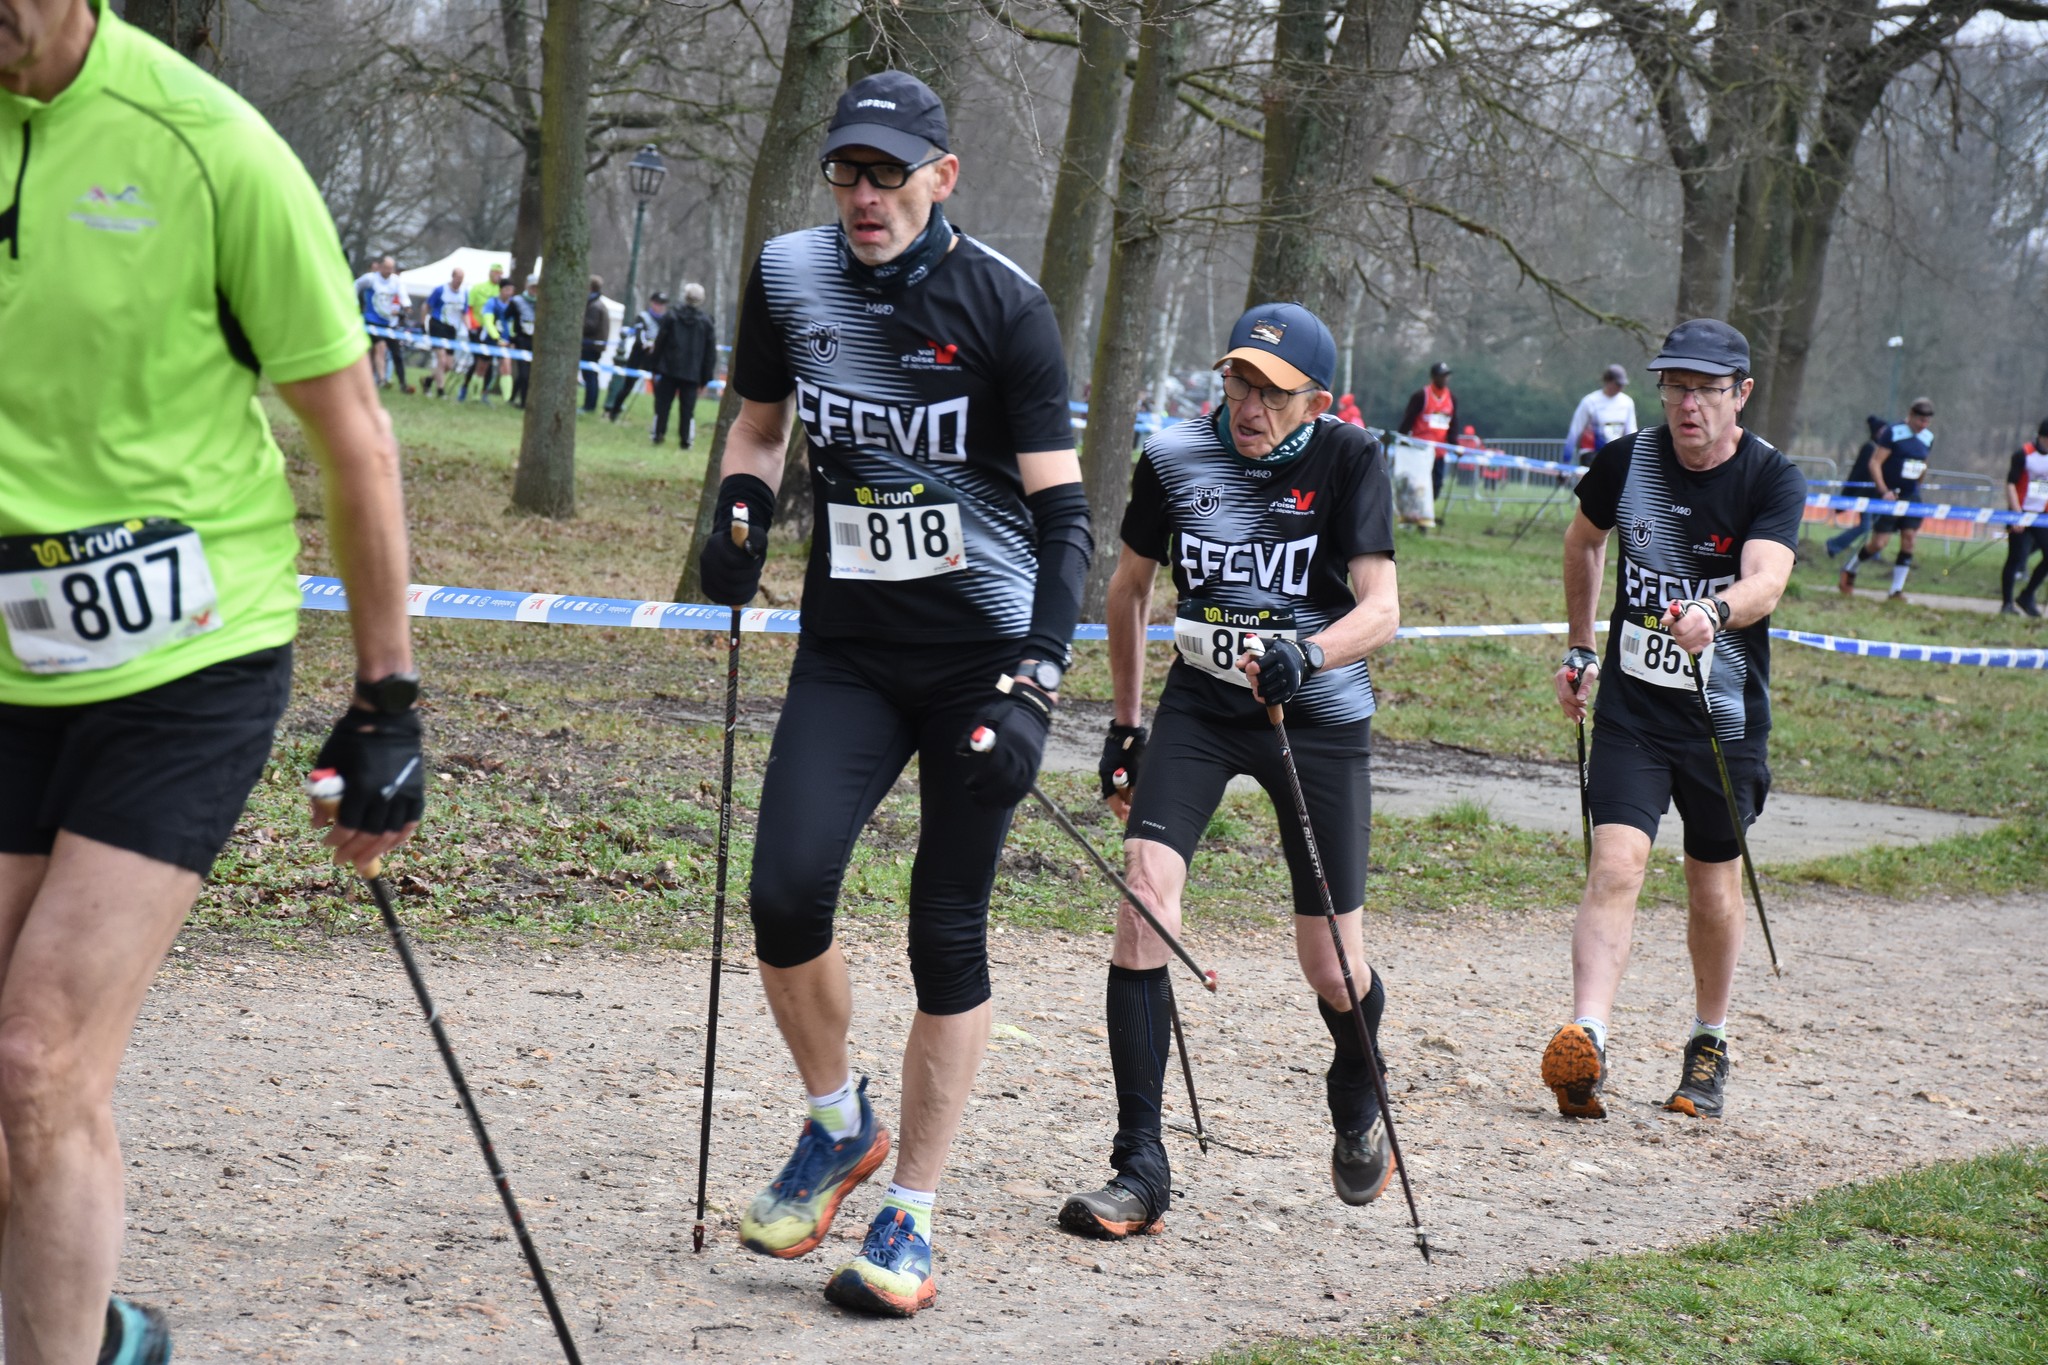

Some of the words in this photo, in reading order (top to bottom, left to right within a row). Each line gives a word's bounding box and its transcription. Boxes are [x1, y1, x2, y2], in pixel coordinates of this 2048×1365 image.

[901, 354, 935, 363] d'oise
[868, 509, 949, 561] 818
[62, 546, 181, 641] 807
[1225, 610, 1260, 626] i-run
[720, 802, 729, 857] GUIDETTI
[1303, 826, 1322, 878] GUIDETTI
